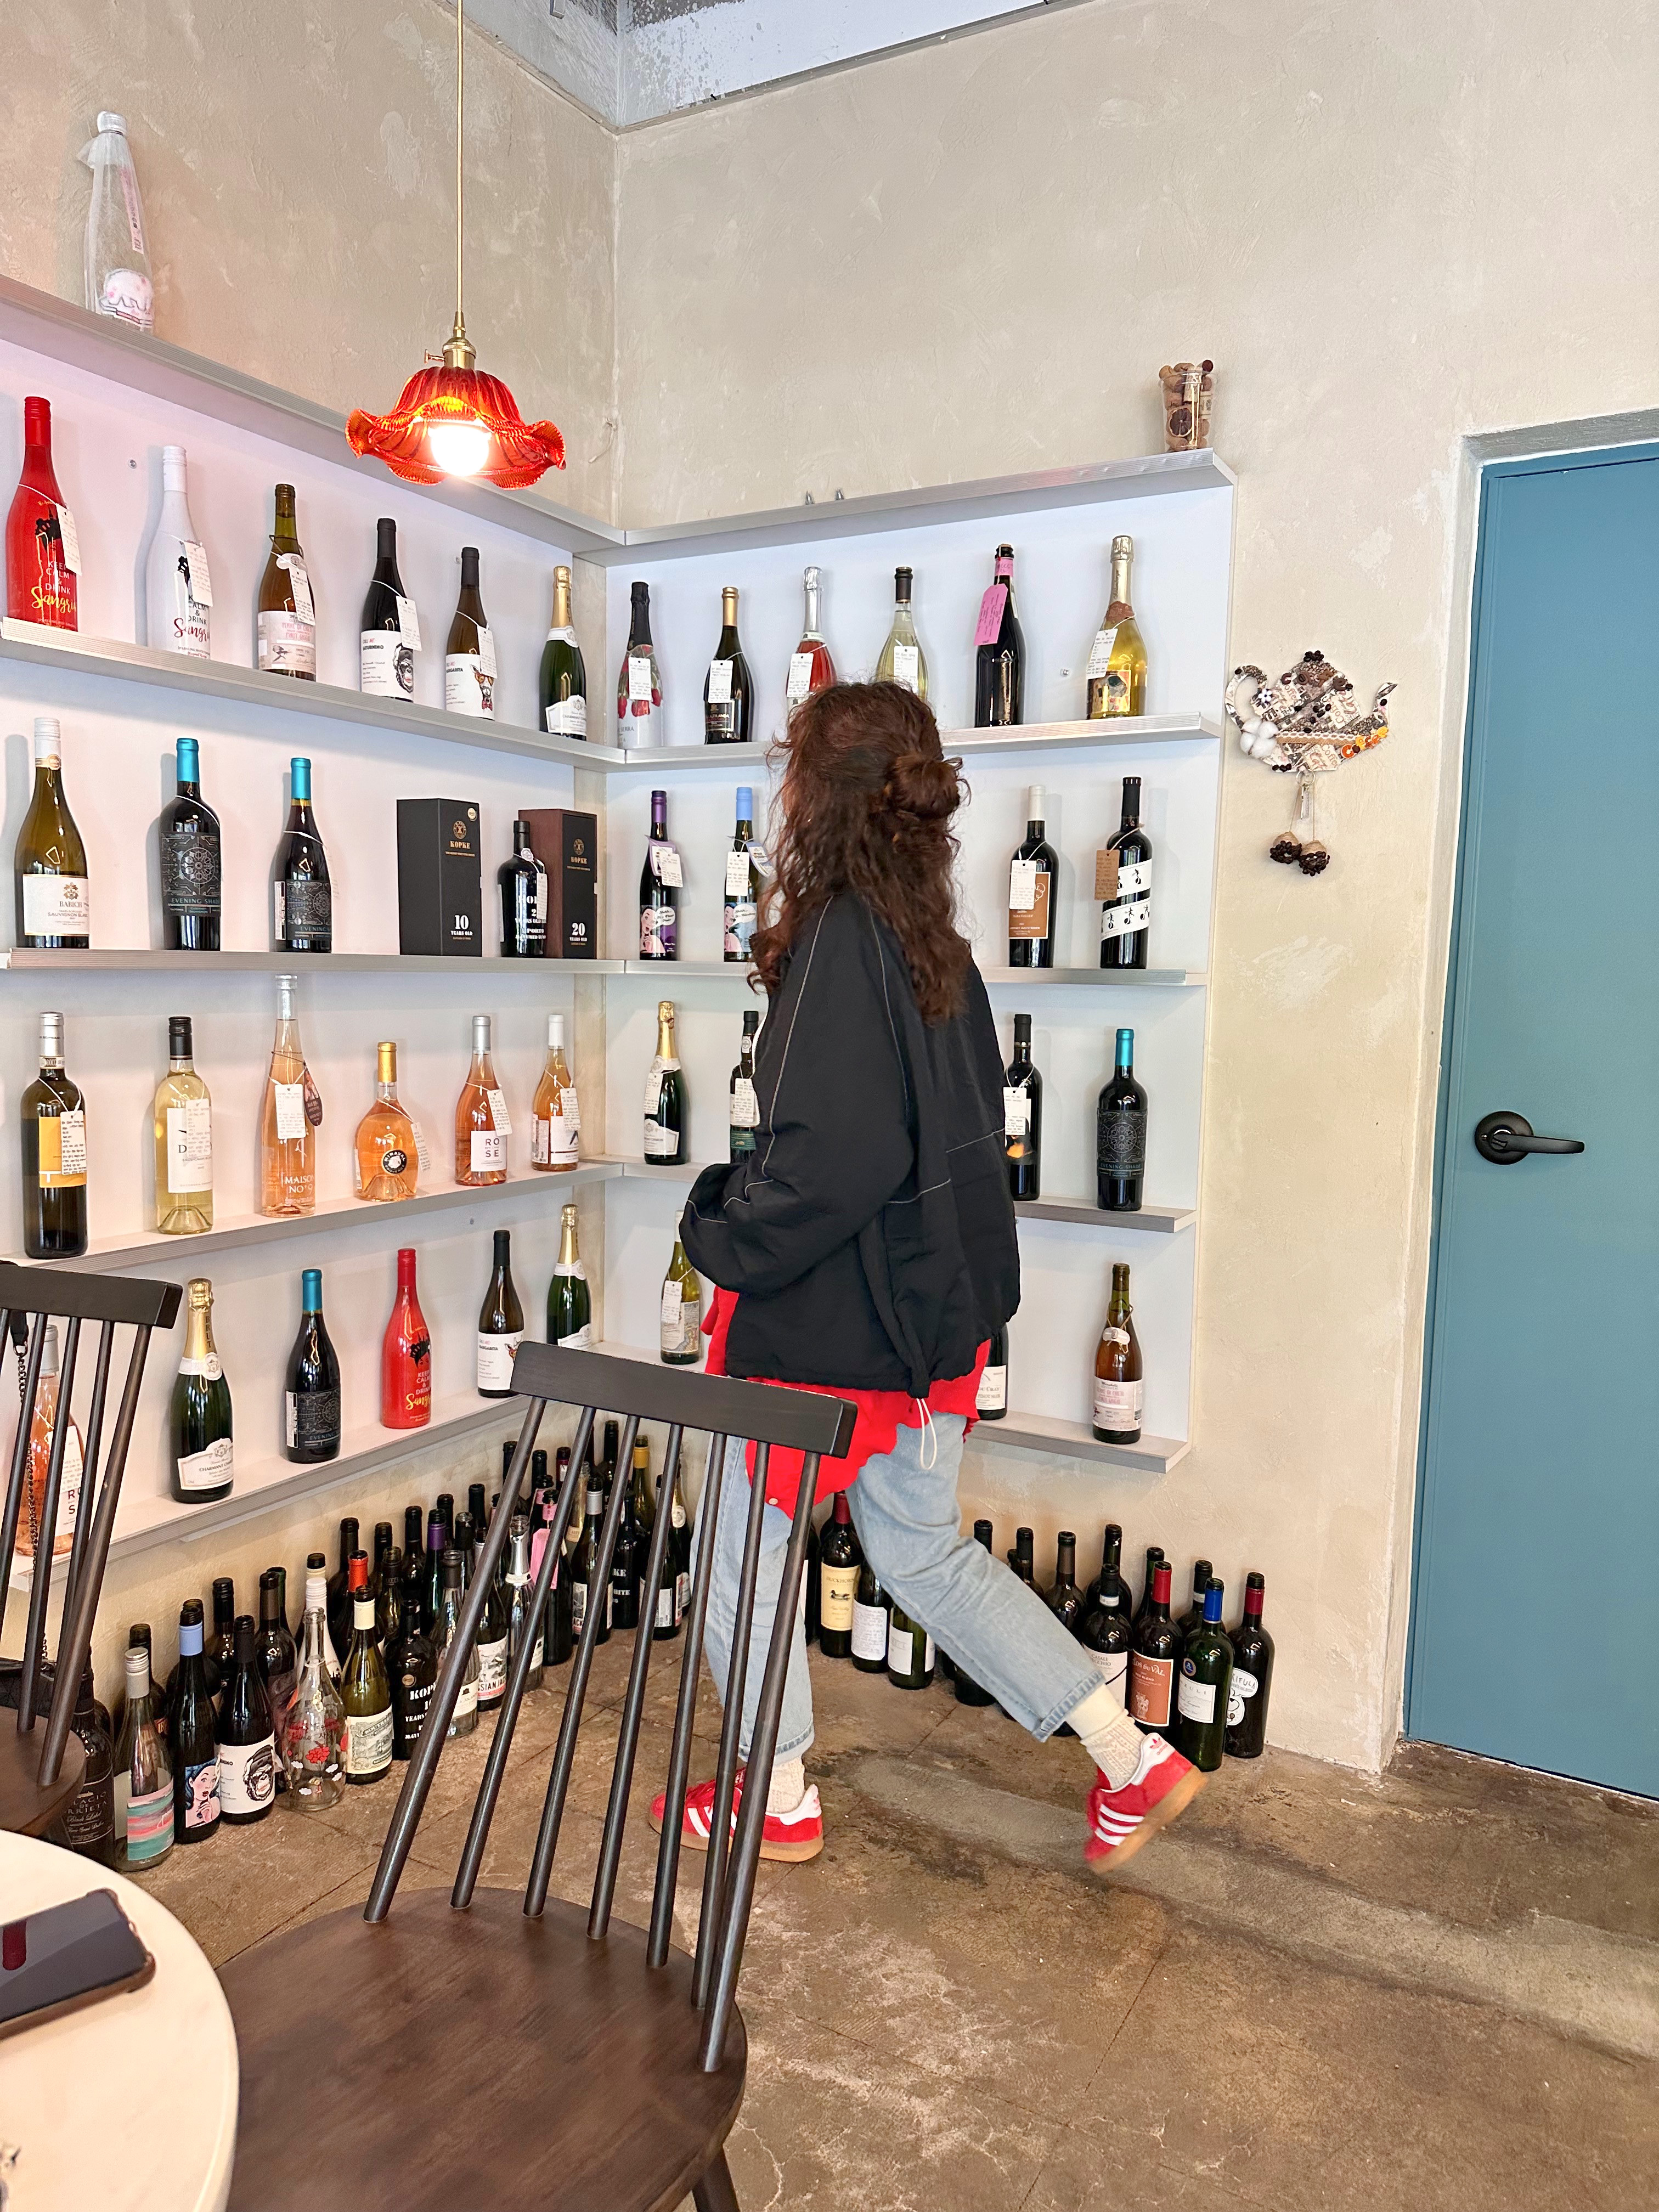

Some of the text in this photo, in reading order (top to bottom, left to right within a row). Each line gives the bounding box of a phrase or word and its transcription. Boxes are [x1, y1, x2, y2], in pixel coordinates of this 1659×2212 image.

[450, 840, 471, 849] KOPKE
[571, 856, 587, 865] KOPKE
[455, 915, 469, 930] 10
[572, 923, 585, 936] 20
[485, 1137, 500, 1146] RO
[485, 1149, 499, 1158] SE
[1092, 1654, 1108, 1662] CASALE
[1150, 1664, 1165, 1677] VAL
[74, 1791, 107, 1805] LACIO
[65, 1801, 108, 1815] RRIETA
